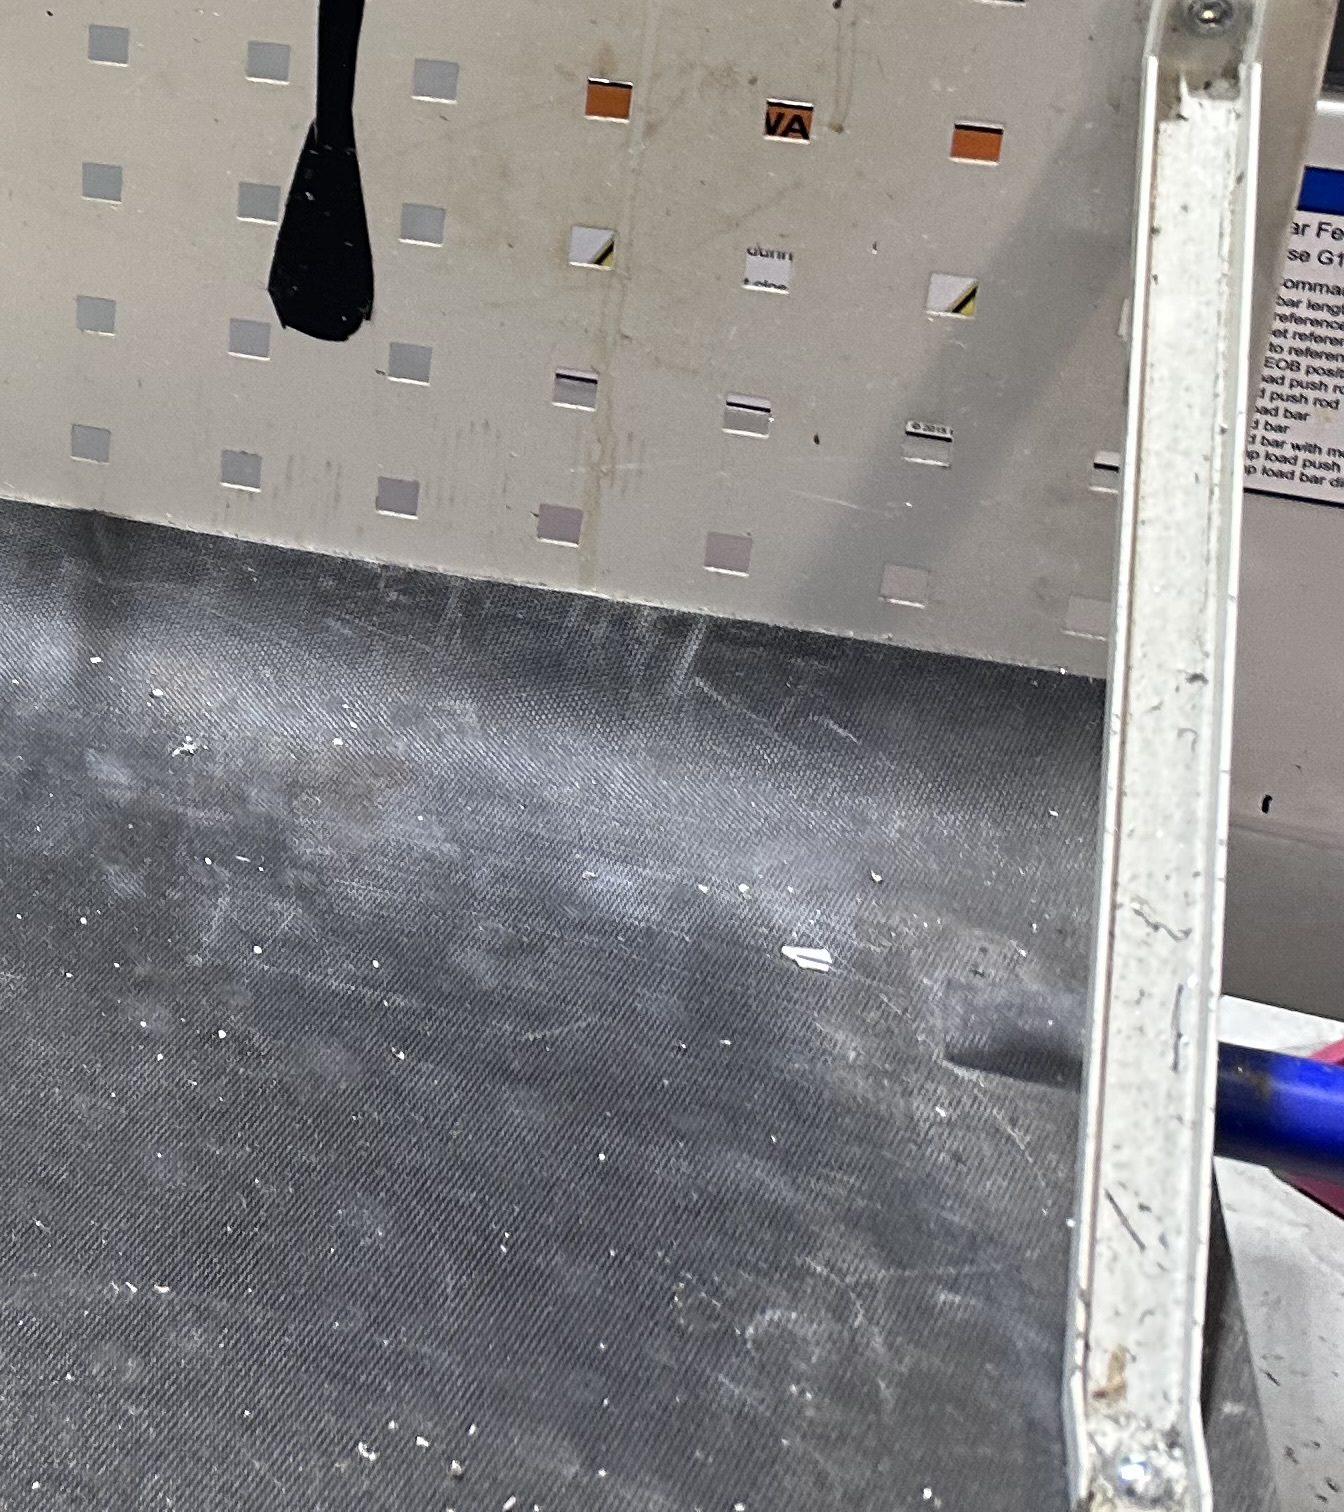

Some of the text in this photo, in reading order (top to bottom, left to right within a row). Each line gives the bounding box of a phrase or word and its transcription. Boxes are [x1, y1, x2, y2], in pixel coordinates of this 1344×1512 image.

[1264, 356, 1301, 372] EOB
[1288, 377, 1328, 393] push
[1269, 390, 1308, 405] push
[1312, 397, 1340, 410] rod
[1283, 407, 1311, 421] bar
[1264, 420, 1290, 434] bar
[1261, 435, 1287, 449] bar
[1290, 441, 1322, 455] with
[1264, 450, 1298, 466] load
[1302, 457, 1341, 474] push
[1262, 464, 1295, 480] load
[1299, 470, 1327, 485] bar
